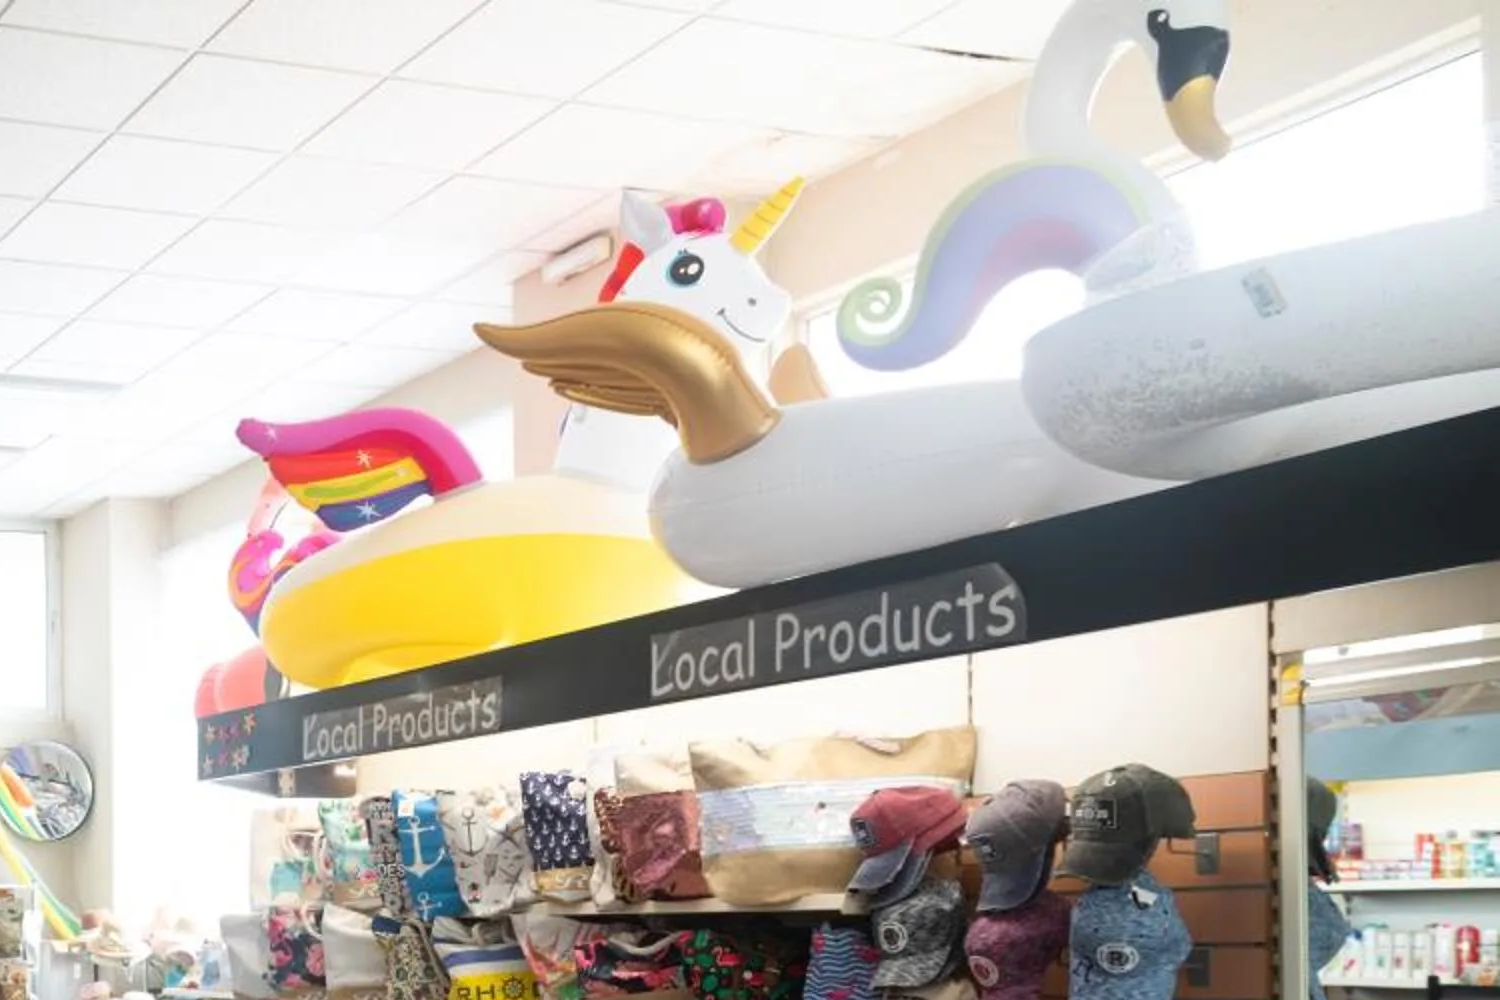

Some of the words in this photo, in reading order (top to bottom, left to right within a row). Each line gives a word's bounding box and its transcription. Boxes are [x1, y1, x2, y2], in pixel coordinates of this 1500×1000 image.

[651, 619, 756, 698] Local
[774, 582, 1016, 673] Products
[303, 704, 363, 760] Local
[373, 690, 496, 749] Products
